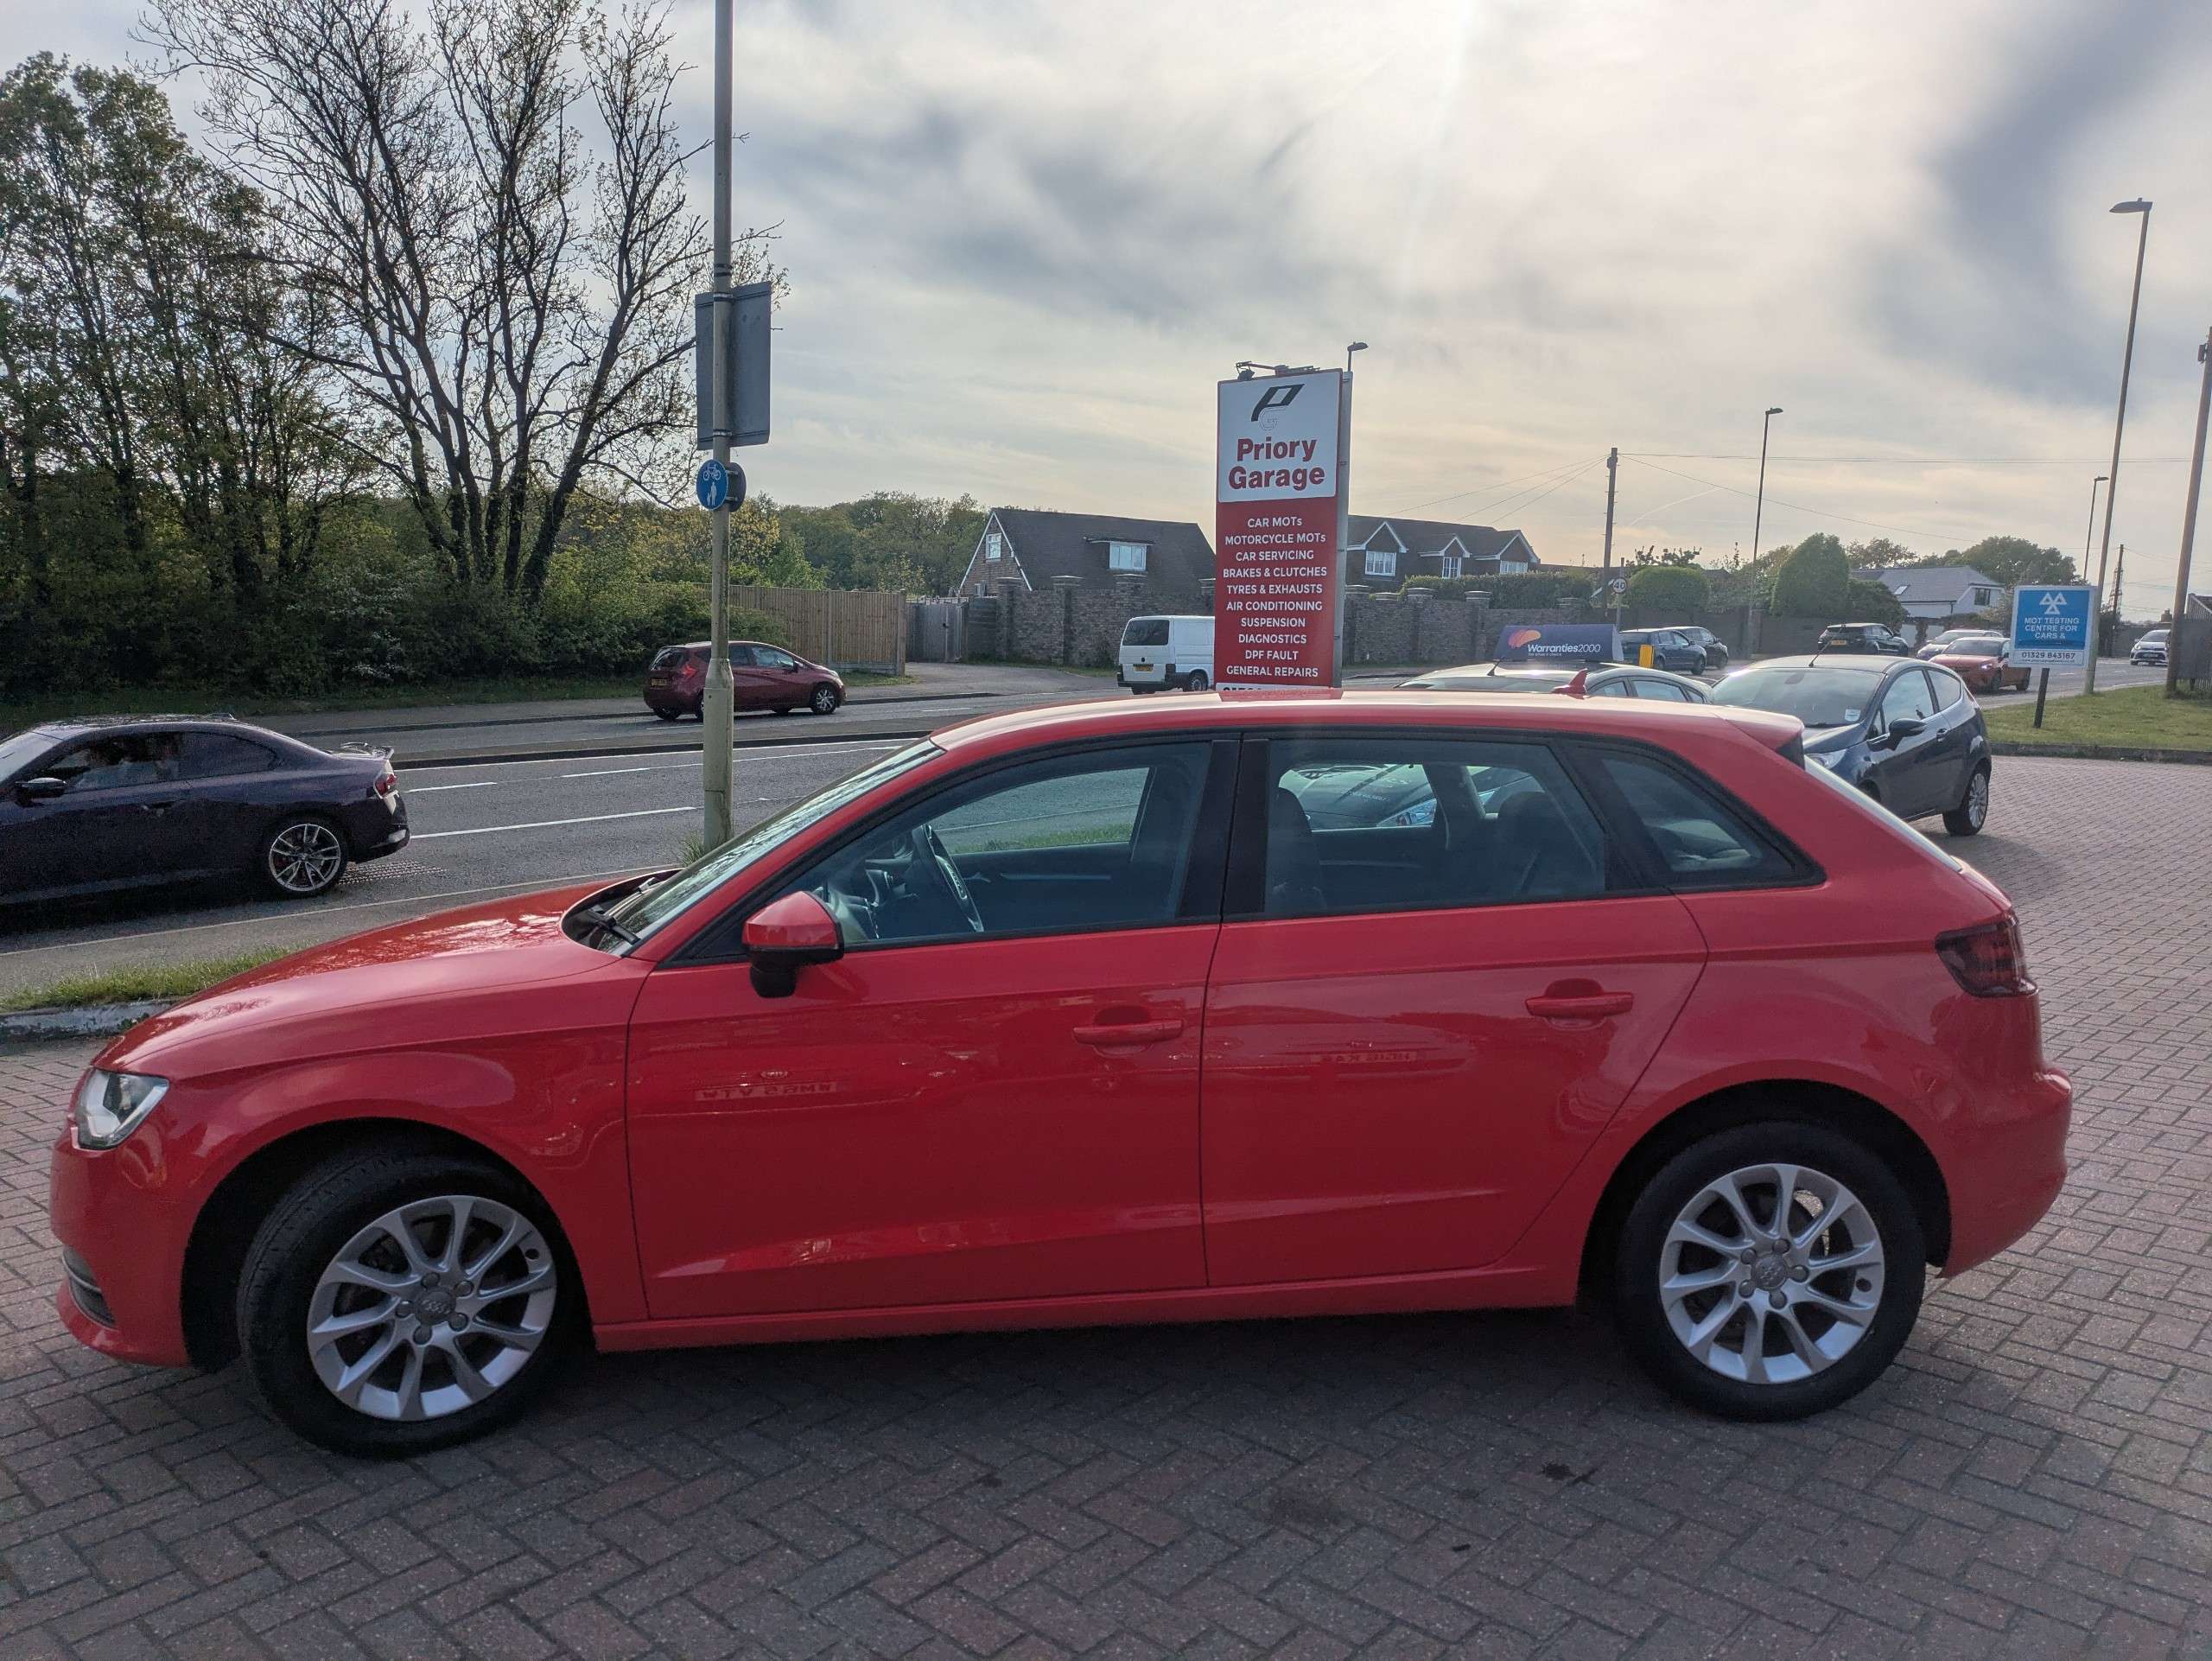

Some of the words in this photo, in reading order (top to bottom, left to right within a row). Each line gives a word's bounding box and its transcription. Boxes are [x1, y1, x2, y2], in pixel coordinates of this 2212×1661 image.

[1236, 436, 1318, 462] Priory
[1228, 465, 1325, 491] Garage
[1247, 518, 1269, 528] CAR
[1272, 516, 1303, 527] MOTs
[1224, 533, 1294, 545] MOTORCYCLE
[1296, 532, 1326, 544] MOTs
[1236, 551, 1255, 562] CAR
[1258, 550, 1314, 561] SERVICING
[1223, 568, 1262, 578] BRAKES
[1264, 567, 1271, 577] &
[1273, 566, 1327, 577] CLUTCHES
[1227, 584, 1257, 595] TYRES
[1260, 584, 1266, 594] &
[1268, 583, 1323, 594] EXHAUSTS
[1226, 601, 1243, 611] AIR
[1245, 601, 1323, 611] CONDITIONING
[1241, 617, 1306, 627] SUSPENSION
[1238, 633, 1307, 644] DIAGNOSTICS
[1528, 643, 1601, 652] Warranties2000
[1245, 650, 1265, 659] DPF
[1267, 650, 1300, 660] FAULT
[1226, 665, 1272, 676] GENERAL
[1274, 666, 1319, 678] REPAIRS
